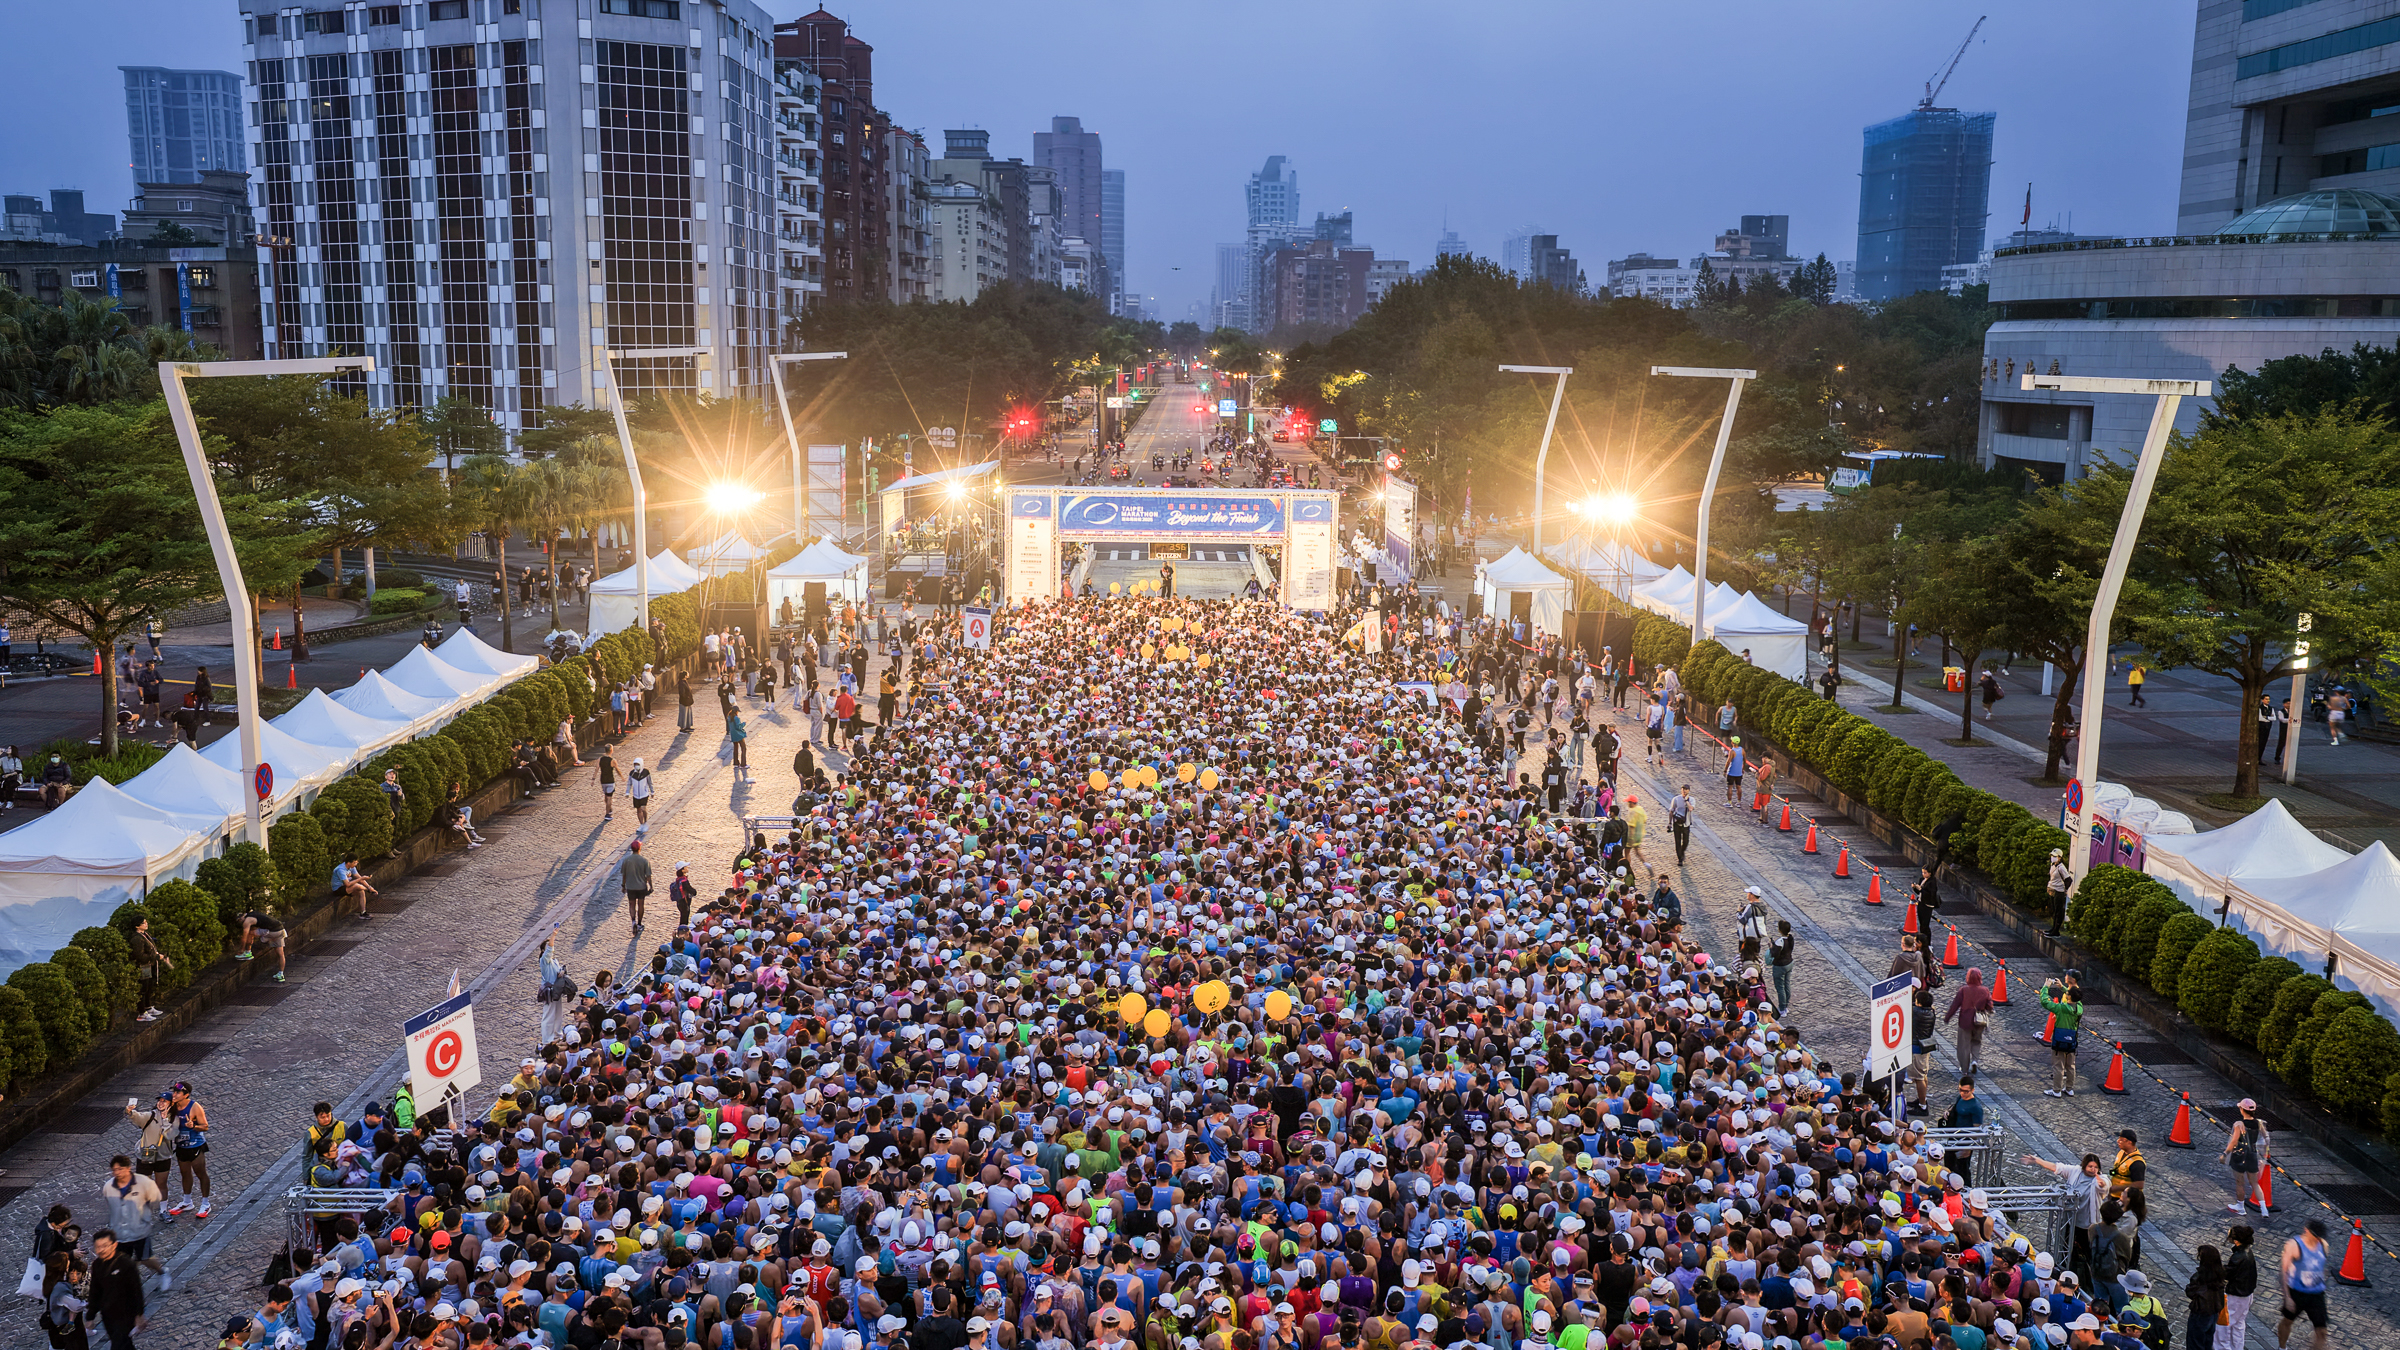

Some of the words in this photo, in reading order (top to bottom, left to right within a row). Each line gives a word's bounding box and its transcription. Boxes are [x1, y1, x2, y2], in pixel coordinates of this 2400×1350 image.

[1167, 510, 1210, 526] Beyond
[1210, 511, 1229, 523] the
[1228, 511, 1260, 527] Finish
[972, 621, 982, 635] A
[2066, 812, 2079, 827] 0-24
[441, 1011, 467, 1028] MARATHON
[1888, 1011, 1901, 1044] B
[434, 1037, 456, 1071] C
